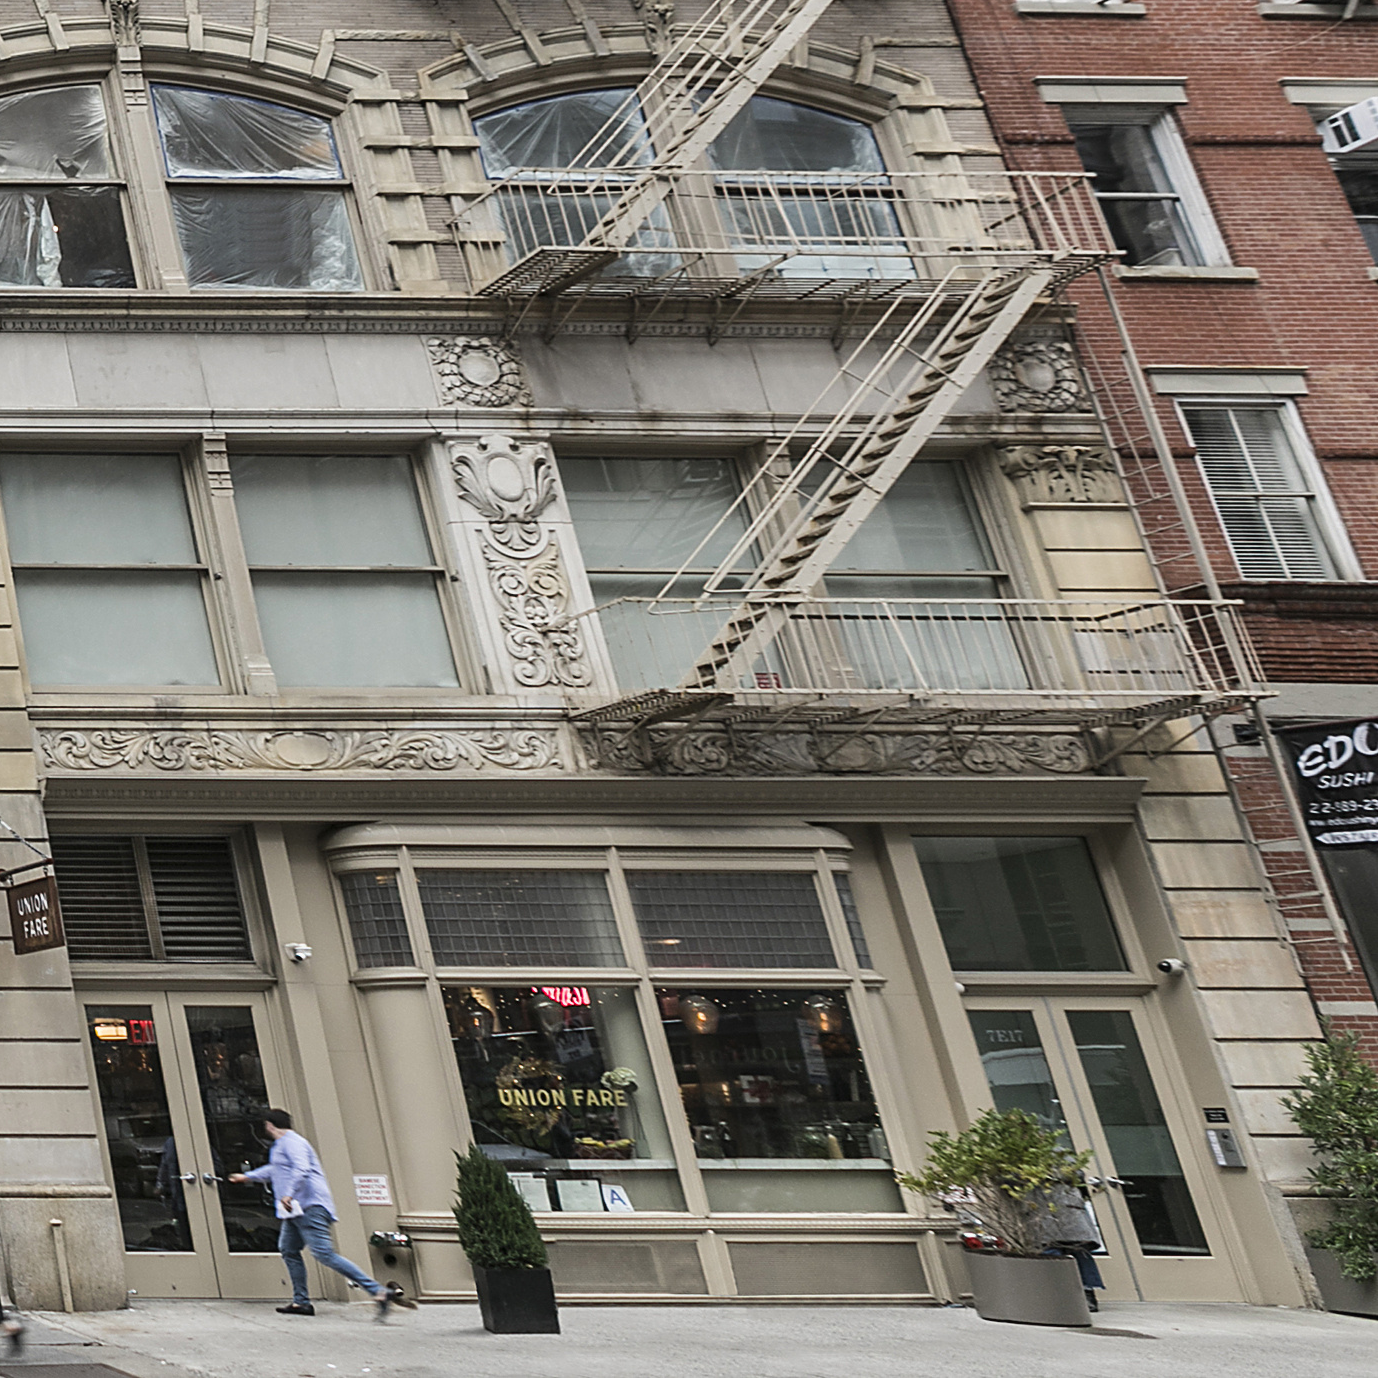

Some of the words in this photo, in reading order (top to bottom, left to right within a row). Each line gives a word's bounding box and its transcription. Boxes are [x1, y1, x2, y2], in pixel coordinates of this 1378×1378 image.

[1317, 771, 1375, 789] SUSHI
[17, 892, 48, 916] UNION
[23, 916, 50, 939] FARE
[129, 1019, 154, 1043] EXI
[986, 1029, 1023, 1042] 7E17
[497, 1089, 567, 1106] UNION
[571, 1089, 629, 1107] FARE
[610, 1189, 627, 1206] A
